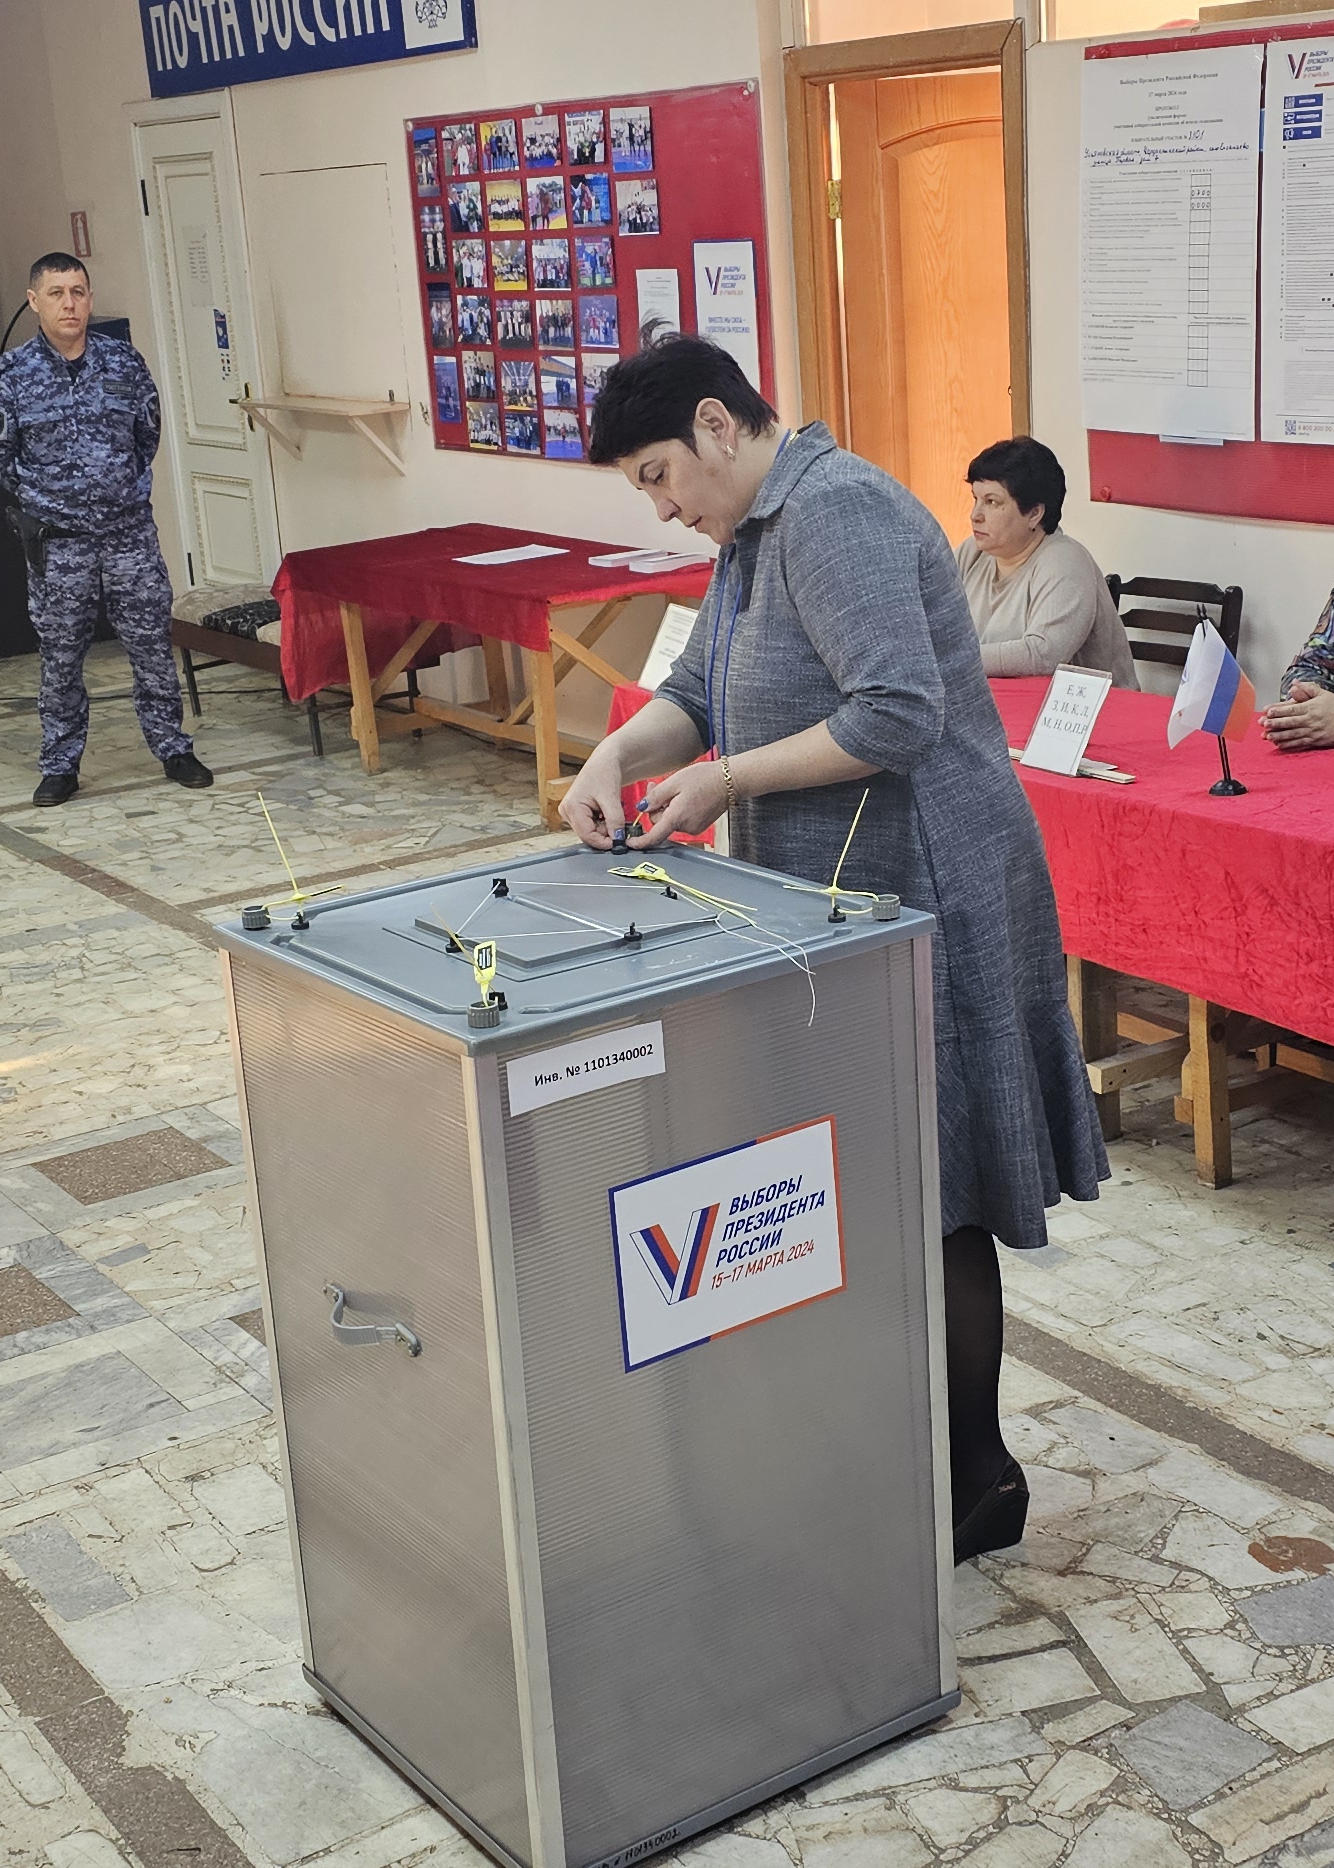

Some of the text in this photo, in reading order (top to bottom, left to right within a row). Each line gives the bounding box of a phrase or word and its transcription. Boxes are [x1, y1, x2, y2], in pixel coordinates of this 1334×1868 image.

[149, 0, 245, 71] ПОЧТА
[534, 1043, 654, 1086] Инв. № 1101340002
[722, 1190, 826, 1242] ПРЕЗИДЕНТА
[728, 1174, 803, 1216] ВЫБОРЫ
[715, 1228, 783, 1268] РОССИИ
[744, 1250, 785, 1277] МАРТА
[786, 1239, 815, 1262] 2024
